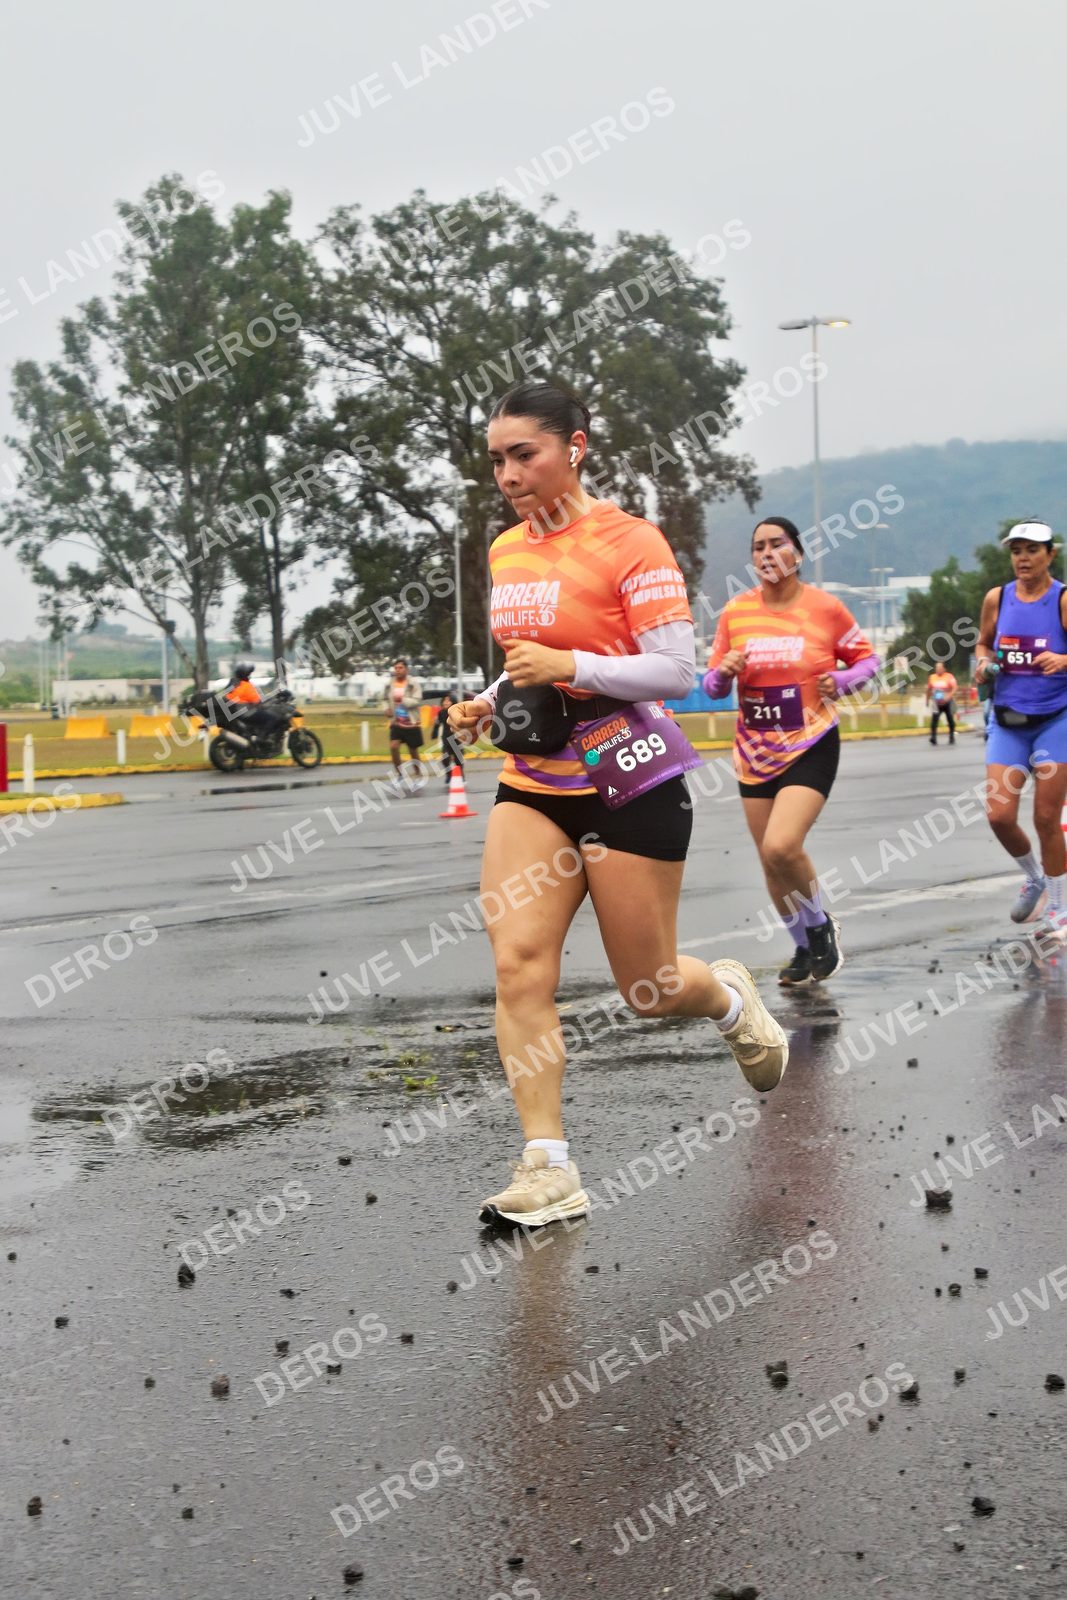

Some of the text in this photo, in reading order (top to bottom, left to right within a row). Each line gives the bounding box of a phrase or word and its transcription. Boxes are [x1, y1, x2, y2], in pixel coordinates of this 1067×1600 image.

[491, 610, 536, 629] MNILIFE
[1007, 651, 1032, 664] 651
[753, 705, 782, 719] 211
[581, 716, 629, 751] CARRERA
[615, 733, 667, 772] 689
